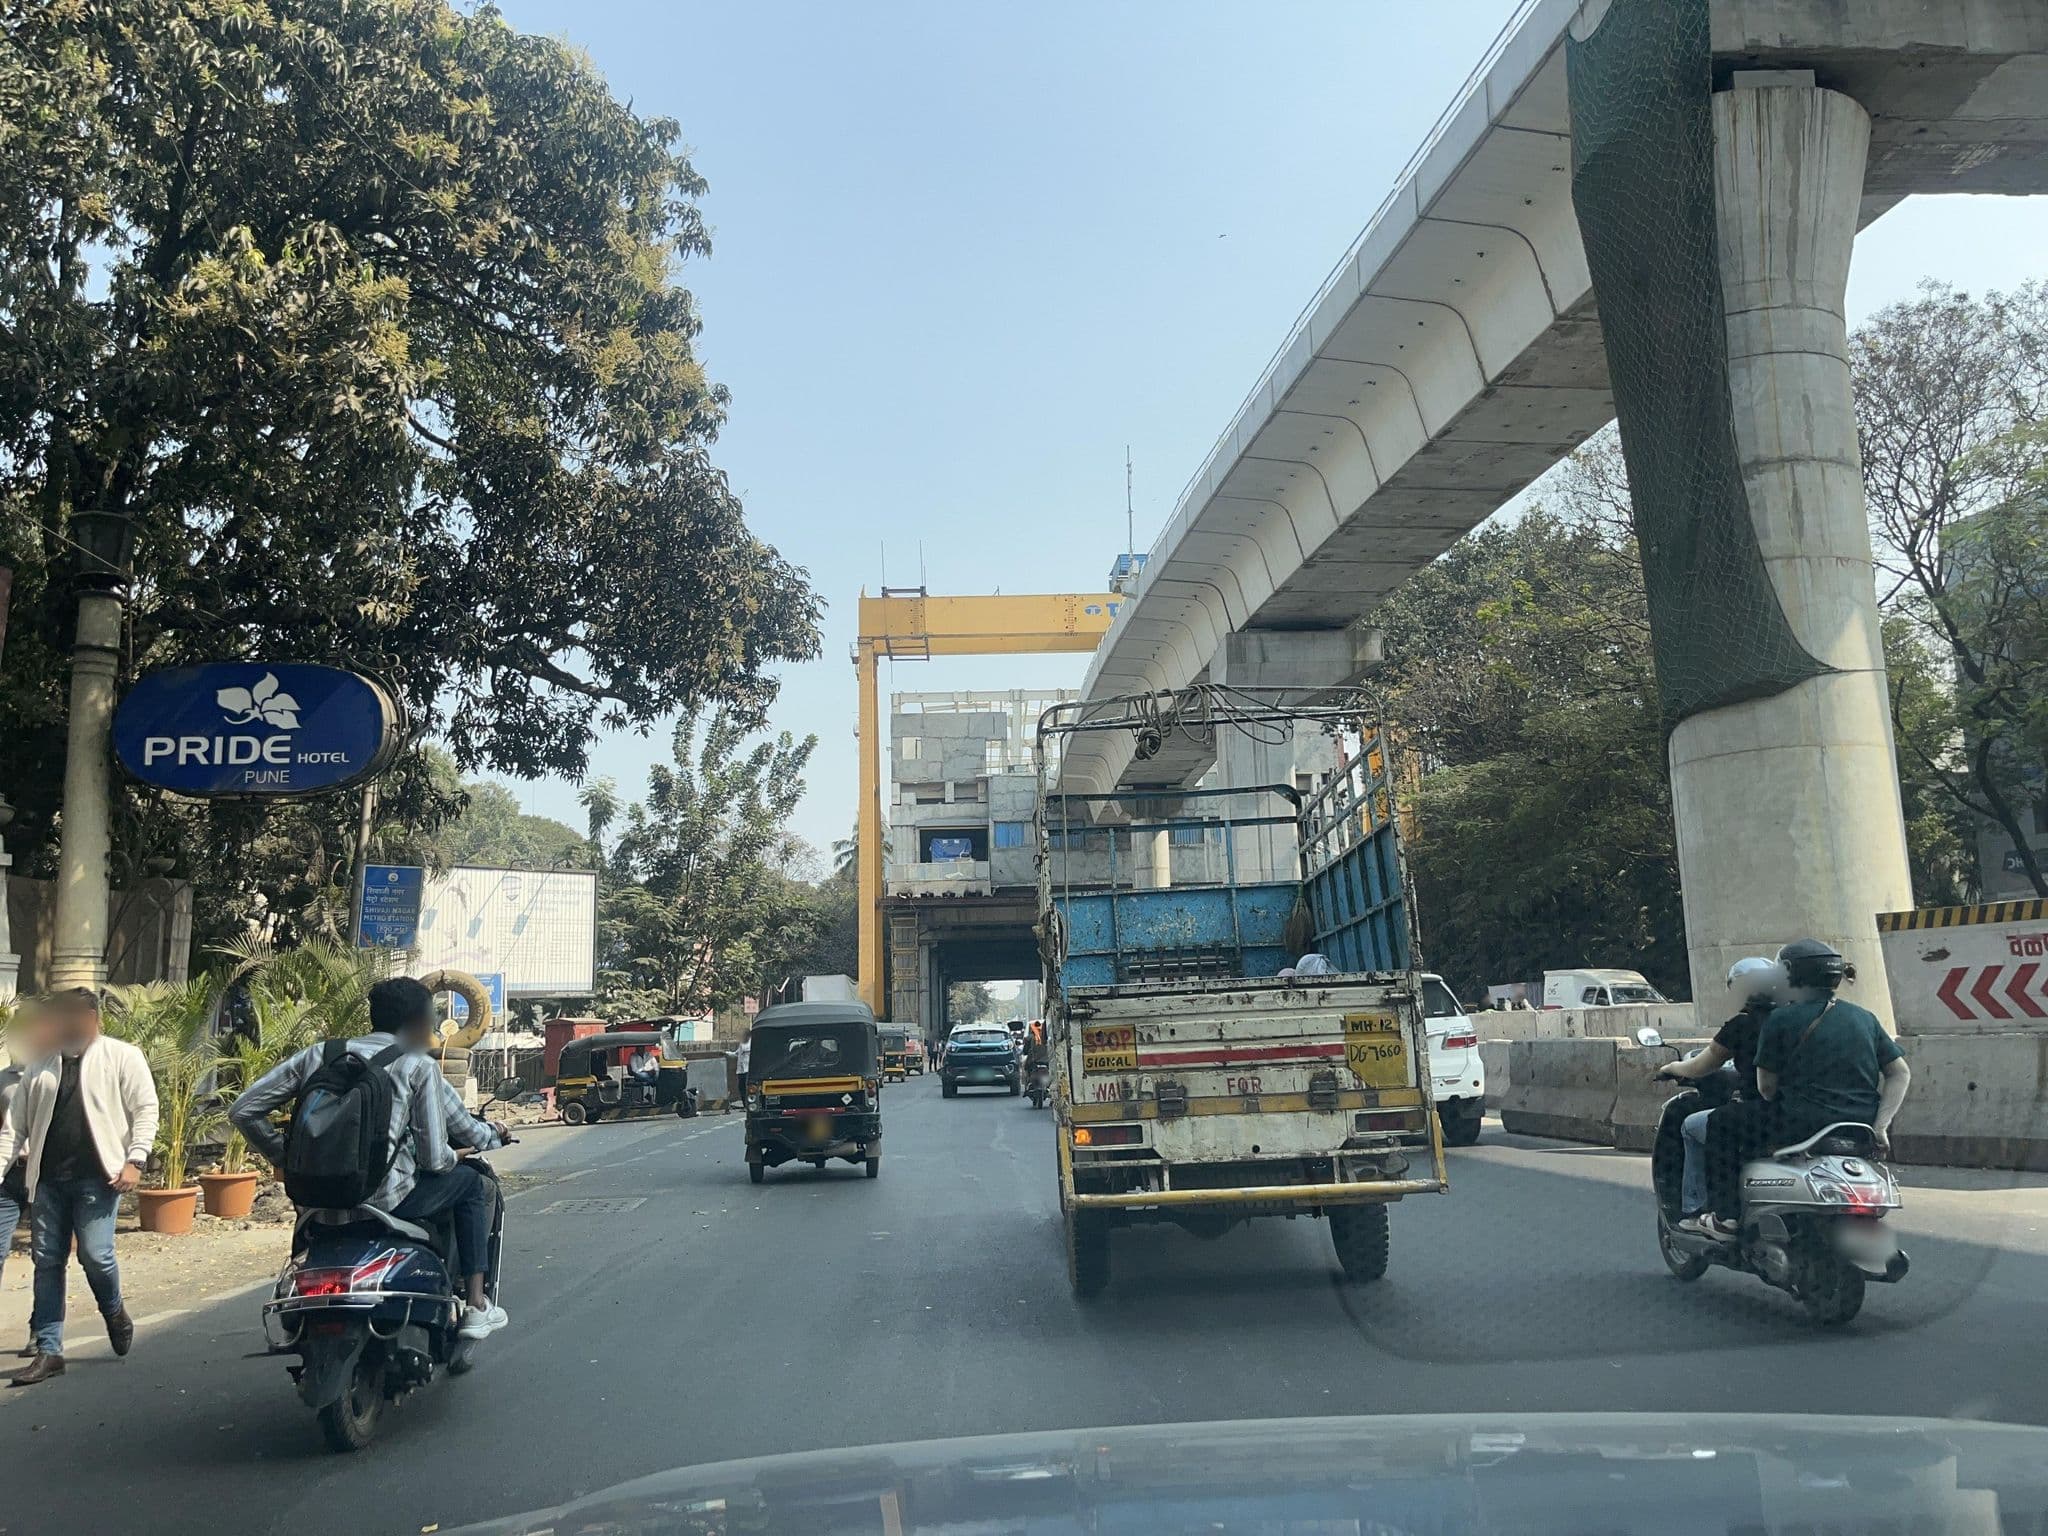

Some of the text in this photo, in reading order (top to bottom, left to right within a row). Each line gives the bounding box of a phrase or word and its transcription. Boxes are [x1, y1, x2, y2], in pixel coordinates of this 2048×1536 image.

[144, 735, 350, 766] PRIDE HOTEL
[244, 770, 290, 784] PUNE
[1086, 1056, 1131, 1068] SIGNAL
[1227, 1076, 1262, 1094] FOR
